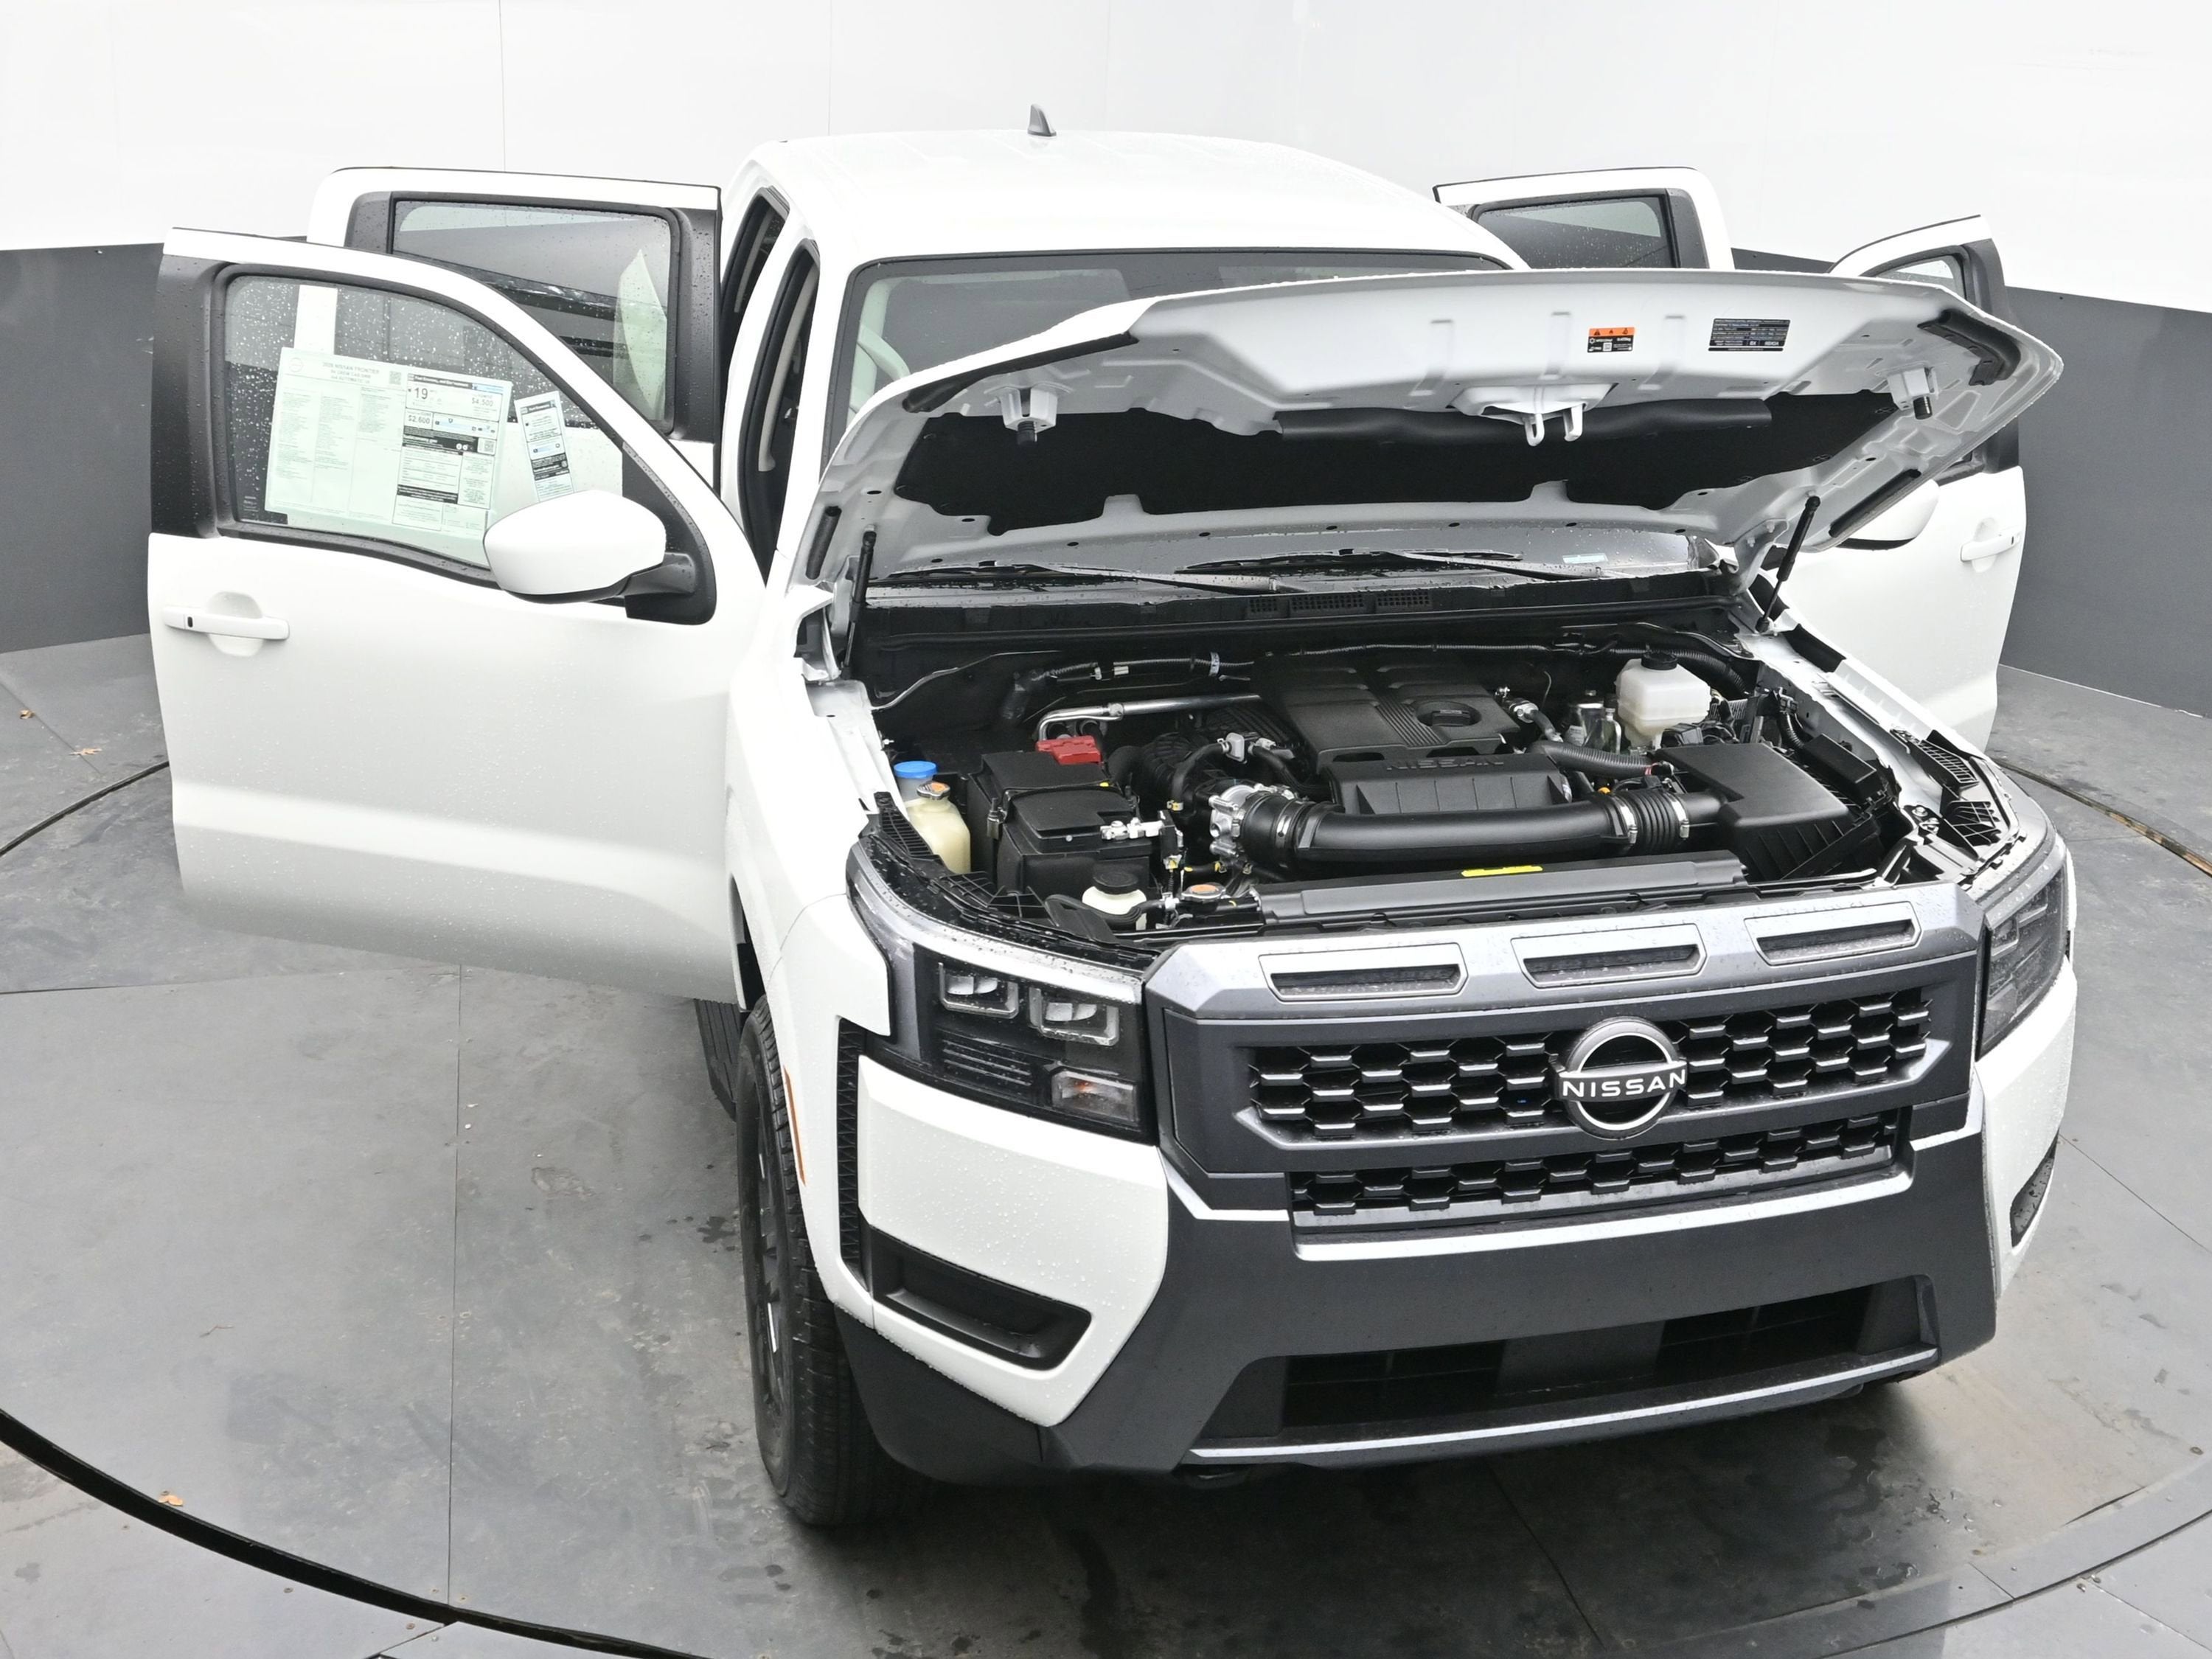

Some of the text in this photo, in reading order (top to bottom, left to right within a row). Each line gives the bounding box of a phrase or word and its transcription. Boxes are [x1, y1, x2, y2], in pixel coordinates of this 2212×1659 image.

[414, 387, 428, 400] 19
[1386, 757, 1505, 771] NISSAN
[1562, 1069, 1686, 1097] NISSAN
